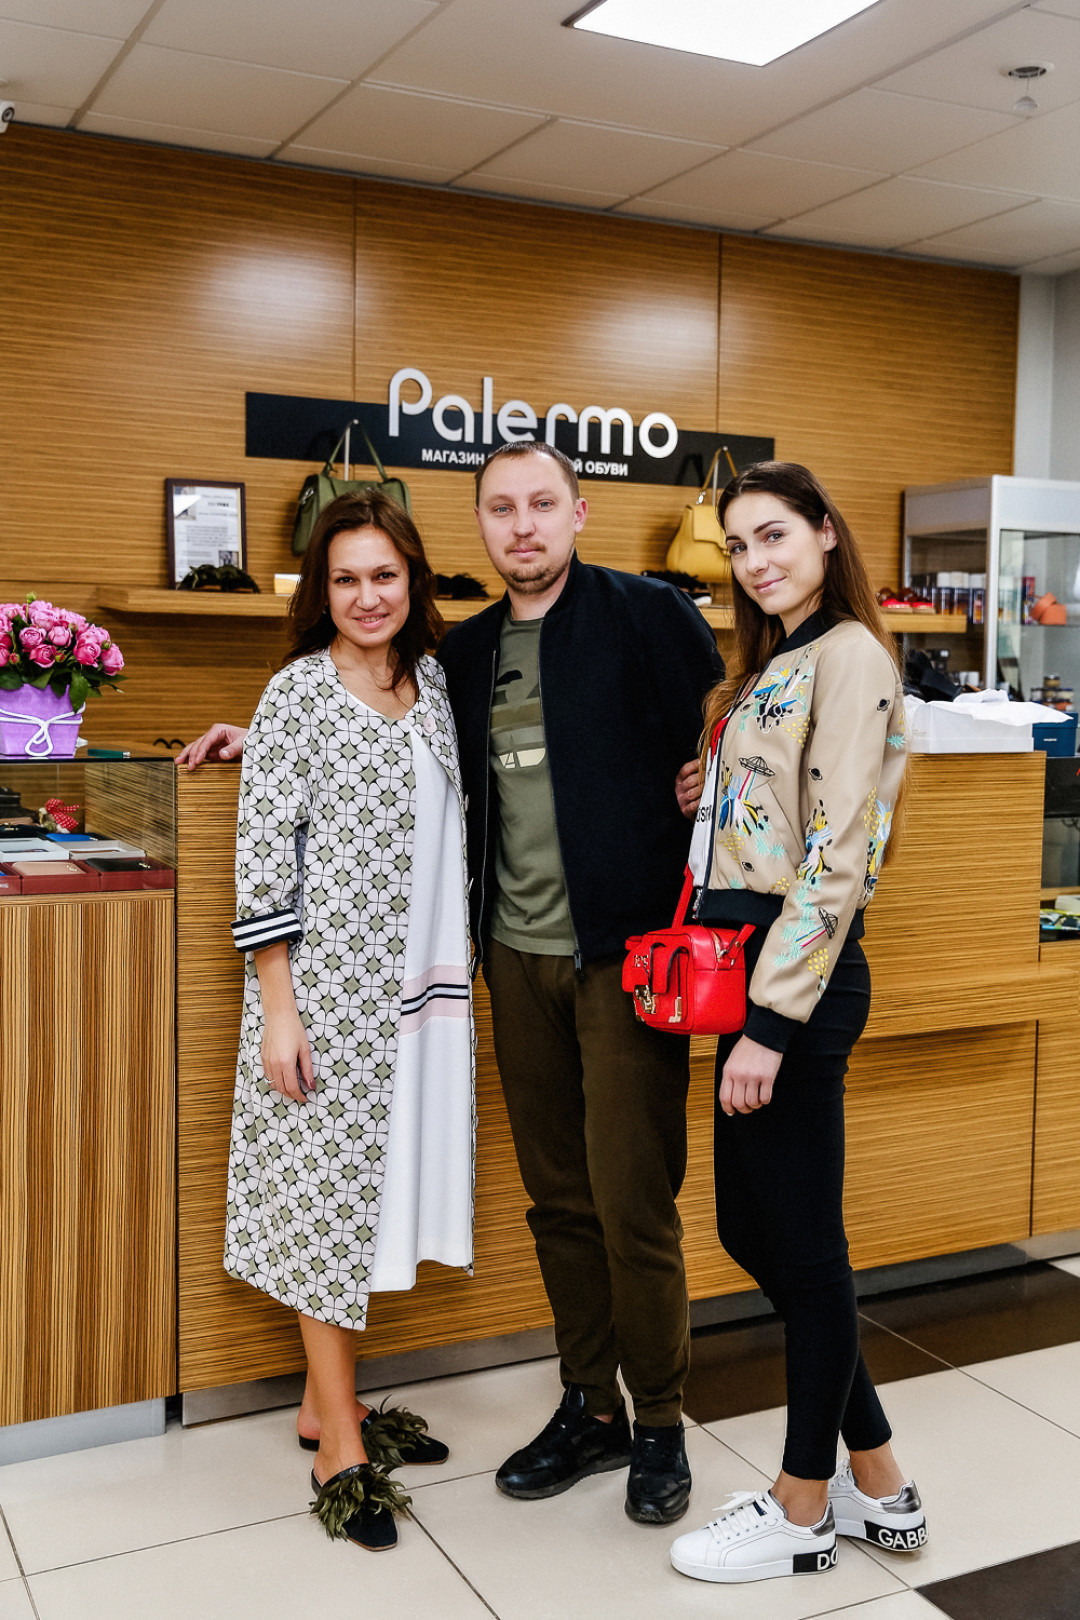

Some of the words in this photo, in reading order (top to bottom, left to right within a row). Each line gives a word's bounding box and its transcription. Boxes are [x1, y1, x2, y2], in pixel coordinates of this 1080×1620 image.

[388, 367, 679, 459] Palermo
[421, 448, 486, 466] МАГАЗИН
[584, 460, 629, 477] ОБУВИ
[878, 1527, 929, 1549] GABB
